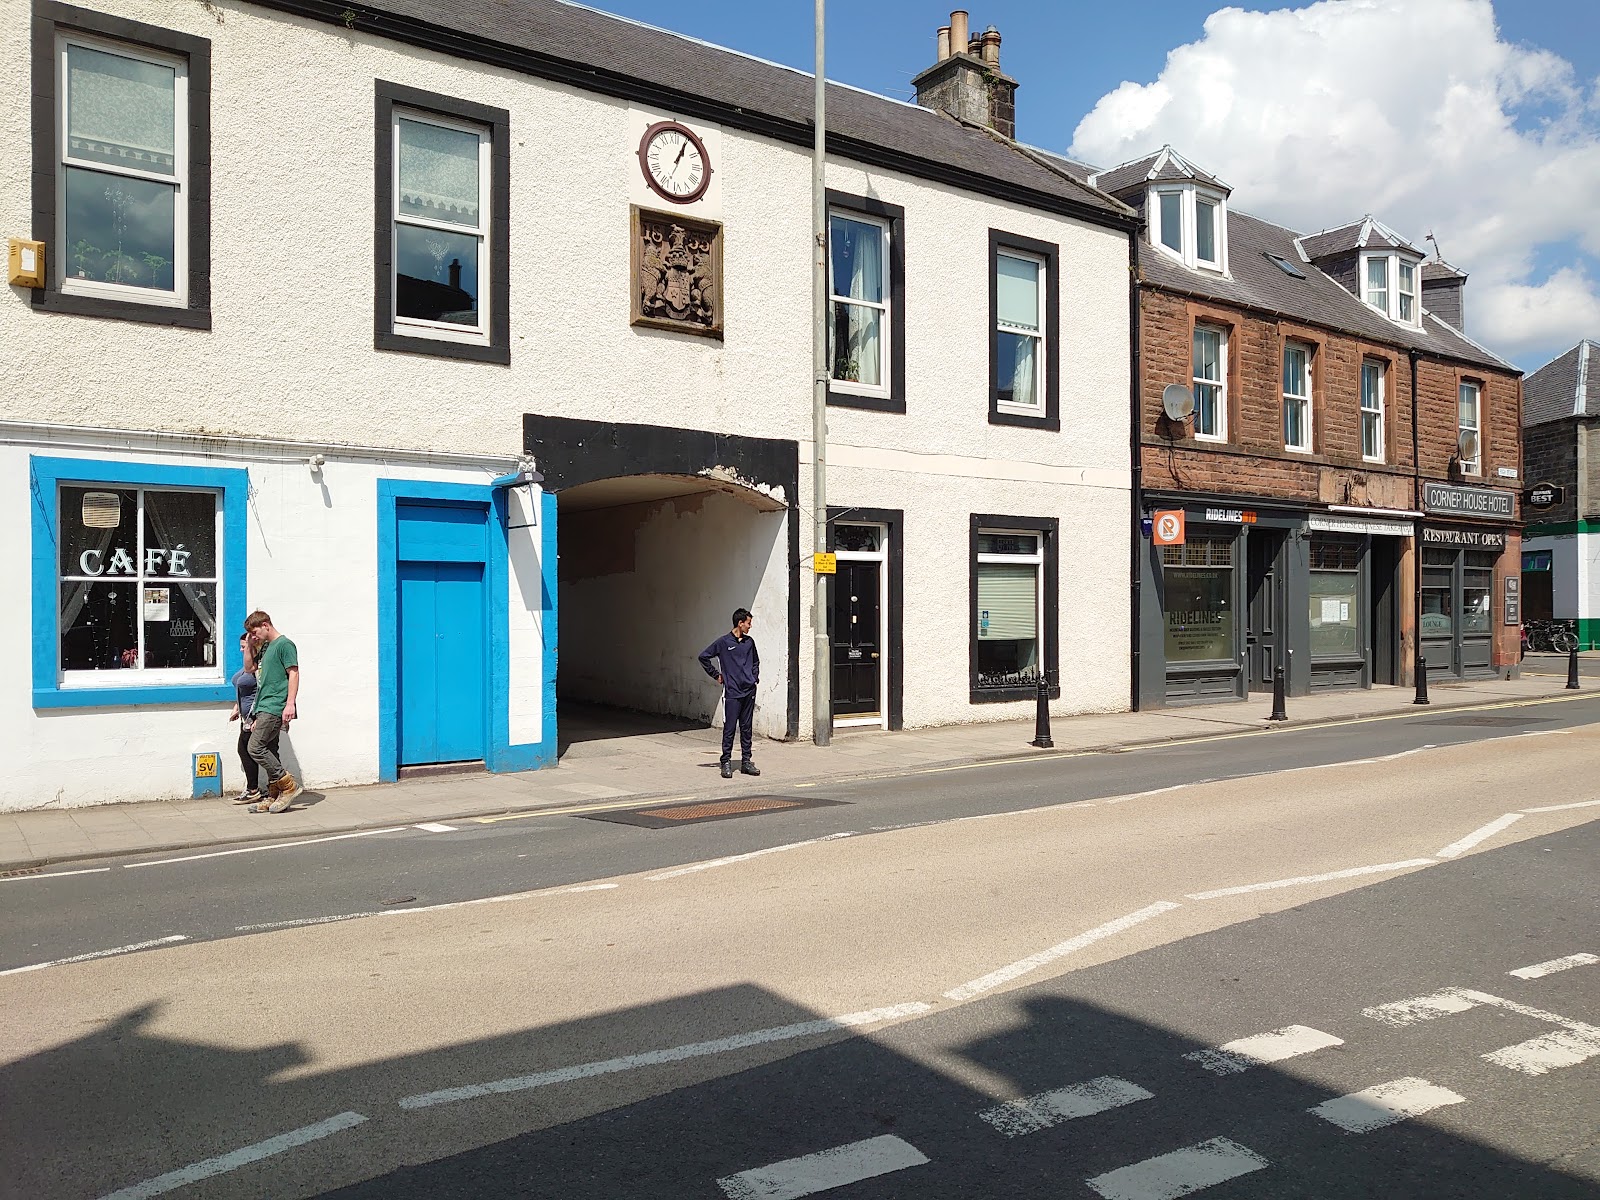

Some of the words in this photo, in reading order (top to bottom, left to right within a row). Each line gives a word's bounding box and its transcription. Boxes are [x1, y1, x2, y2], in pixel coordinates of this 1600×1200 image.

[1430, 489, 1462, 508] CORNER
[1463, 493, 1487, 511] HOUSE
[1488, 496, 1510, 513] HOTEL
[1530, 495, 1554, 503] BEST
[1205, 508, 1243, 523] RIDELINES
[1310, 517, 1336, 528] CORNER
[1337, 519, 1357, 529] HOUSE
[1358, 521, 1383, 531] CHINESE
[1423, 527, 1480, 545] RESTAURANT
[1481, 533, 1504, 546] OPEN
[79, 543, 192, 577] CAFÉ
[170, 619, 194, 628] TAKE
[1169, 610, 1222, 625] RIDELINES
[169, 628, 195, 636] AWAY
[199, 762, 214, 772] SV
